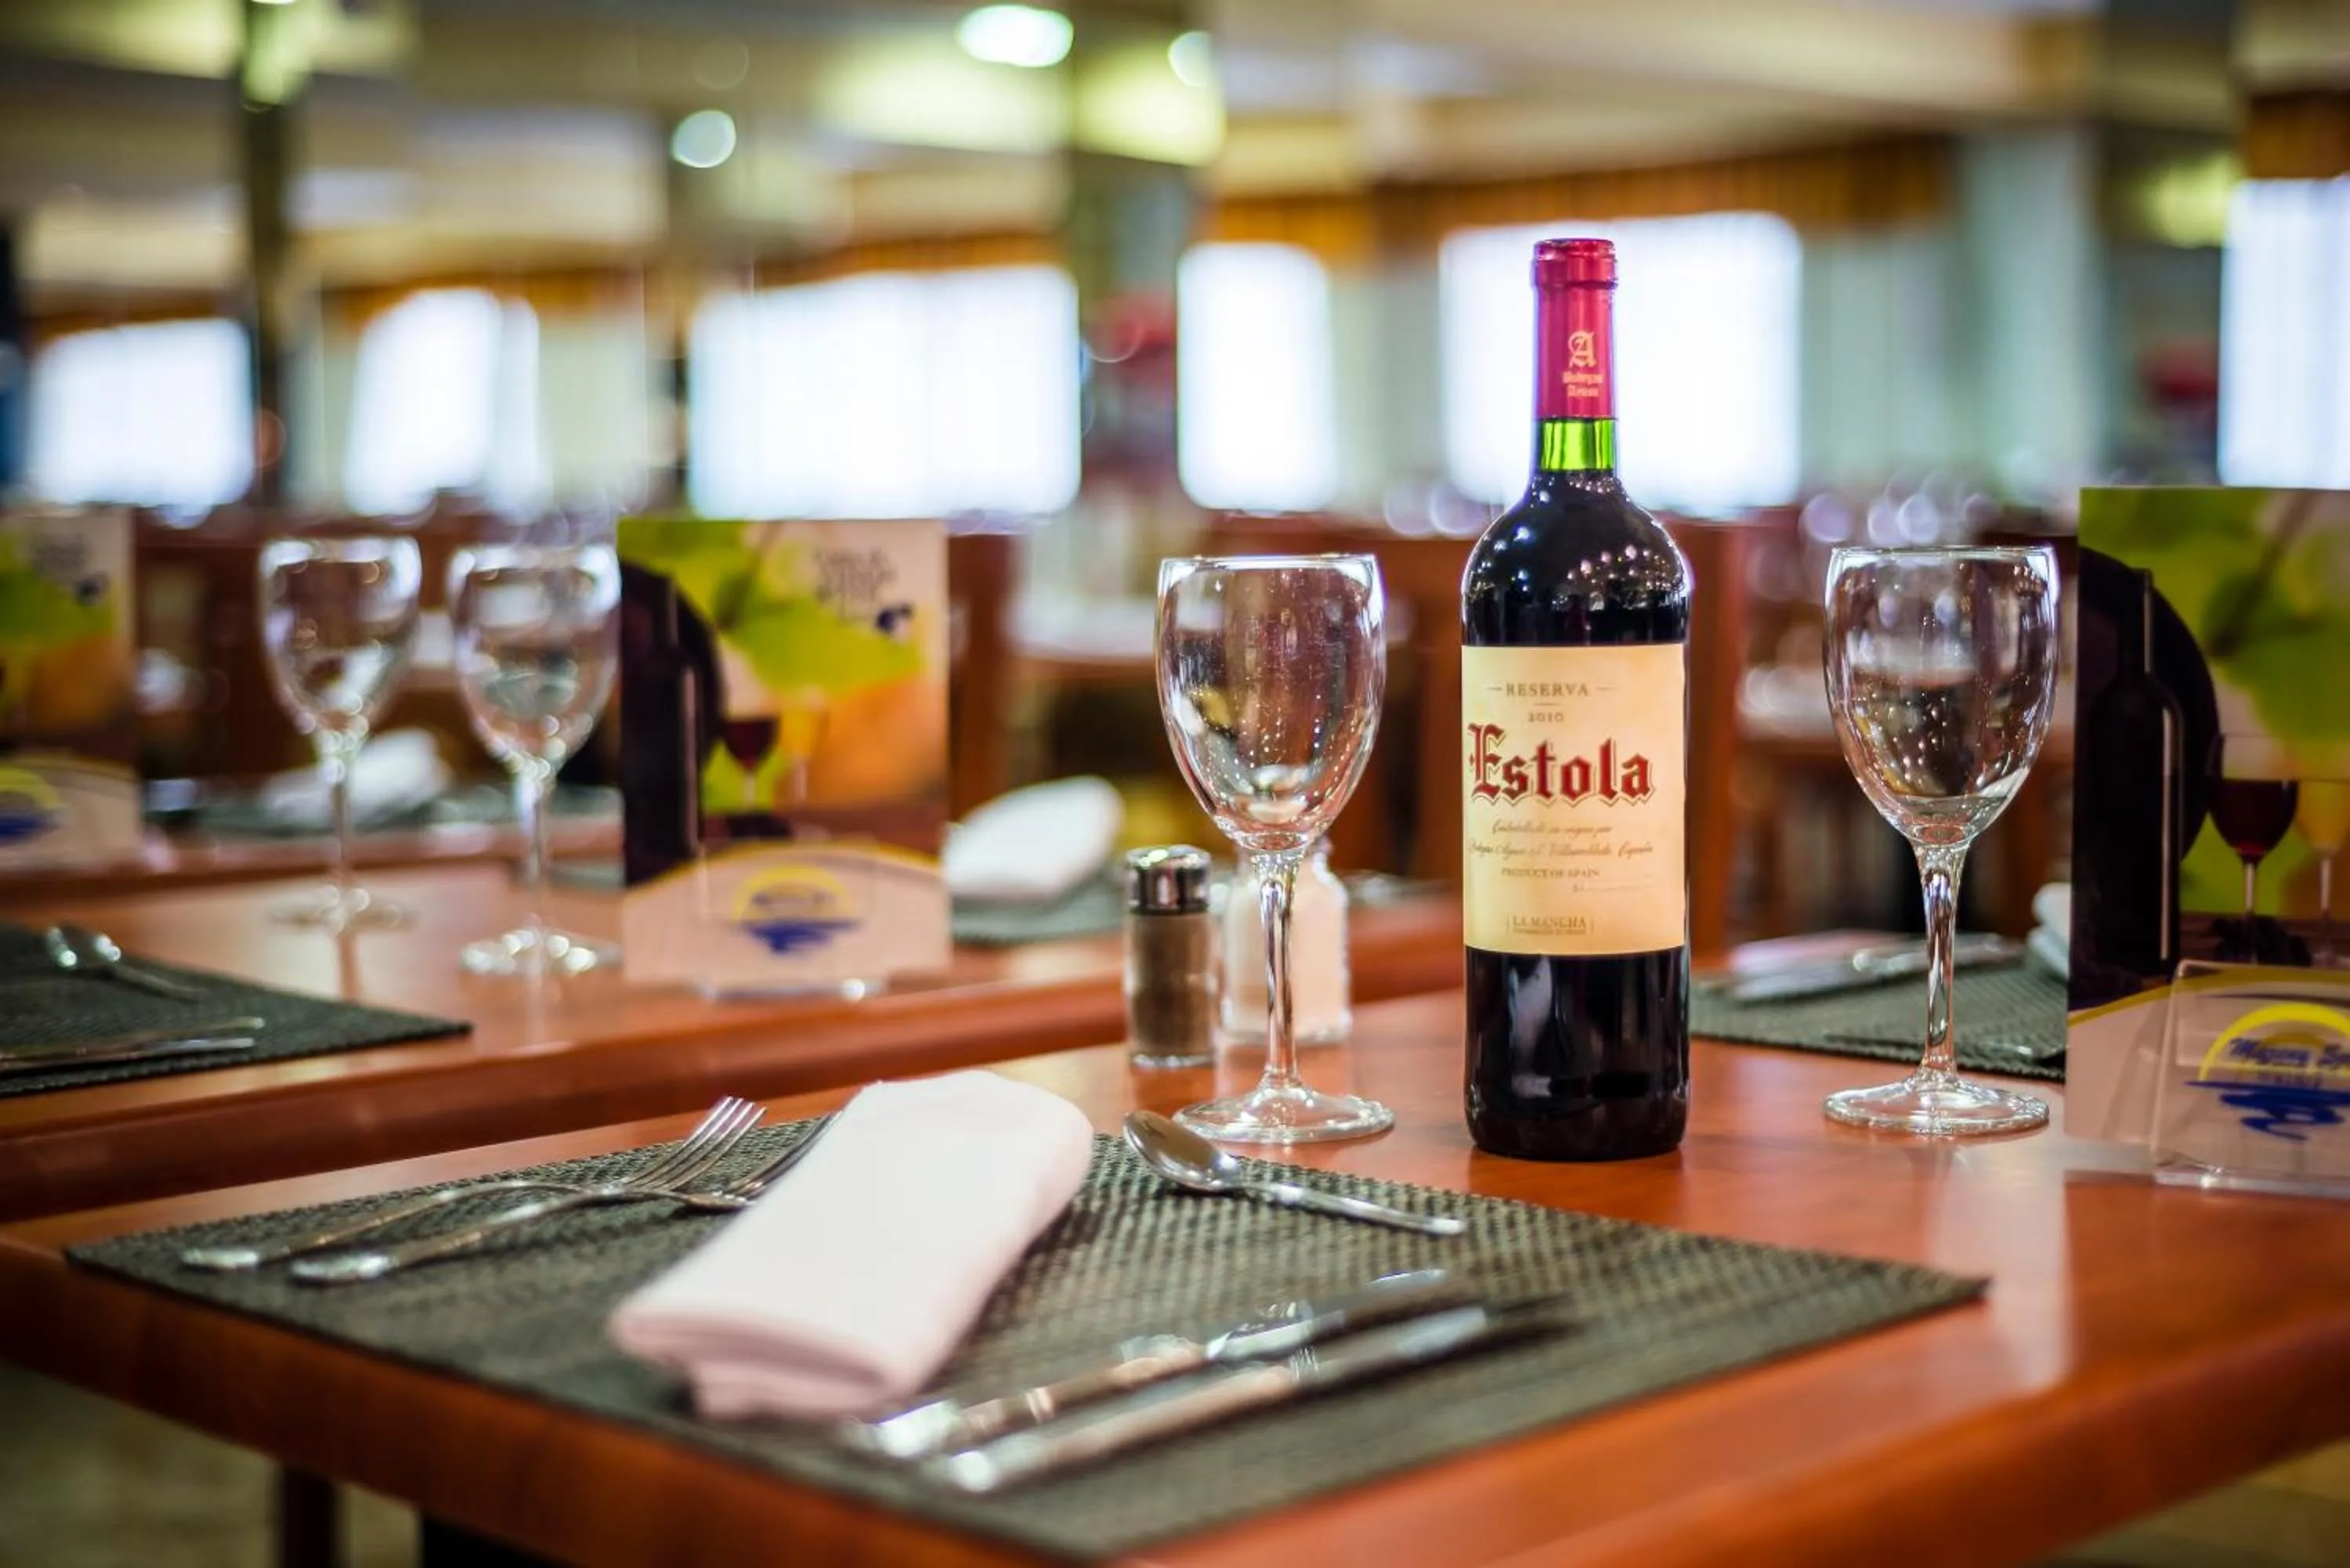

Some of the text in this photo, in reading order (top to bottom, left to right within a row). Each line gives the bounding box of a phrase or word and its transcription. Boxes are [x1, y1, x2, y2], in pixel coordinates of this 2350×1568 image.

[1506, 683, 1589, 697] RESERVA
[1528, 712, 1564, 723] 2010
[1467, 723, 1654, 807] Estola
[1567, 869, 1600, 878] SPAIN
[1529, 916, 1586, 929] MANCHA
